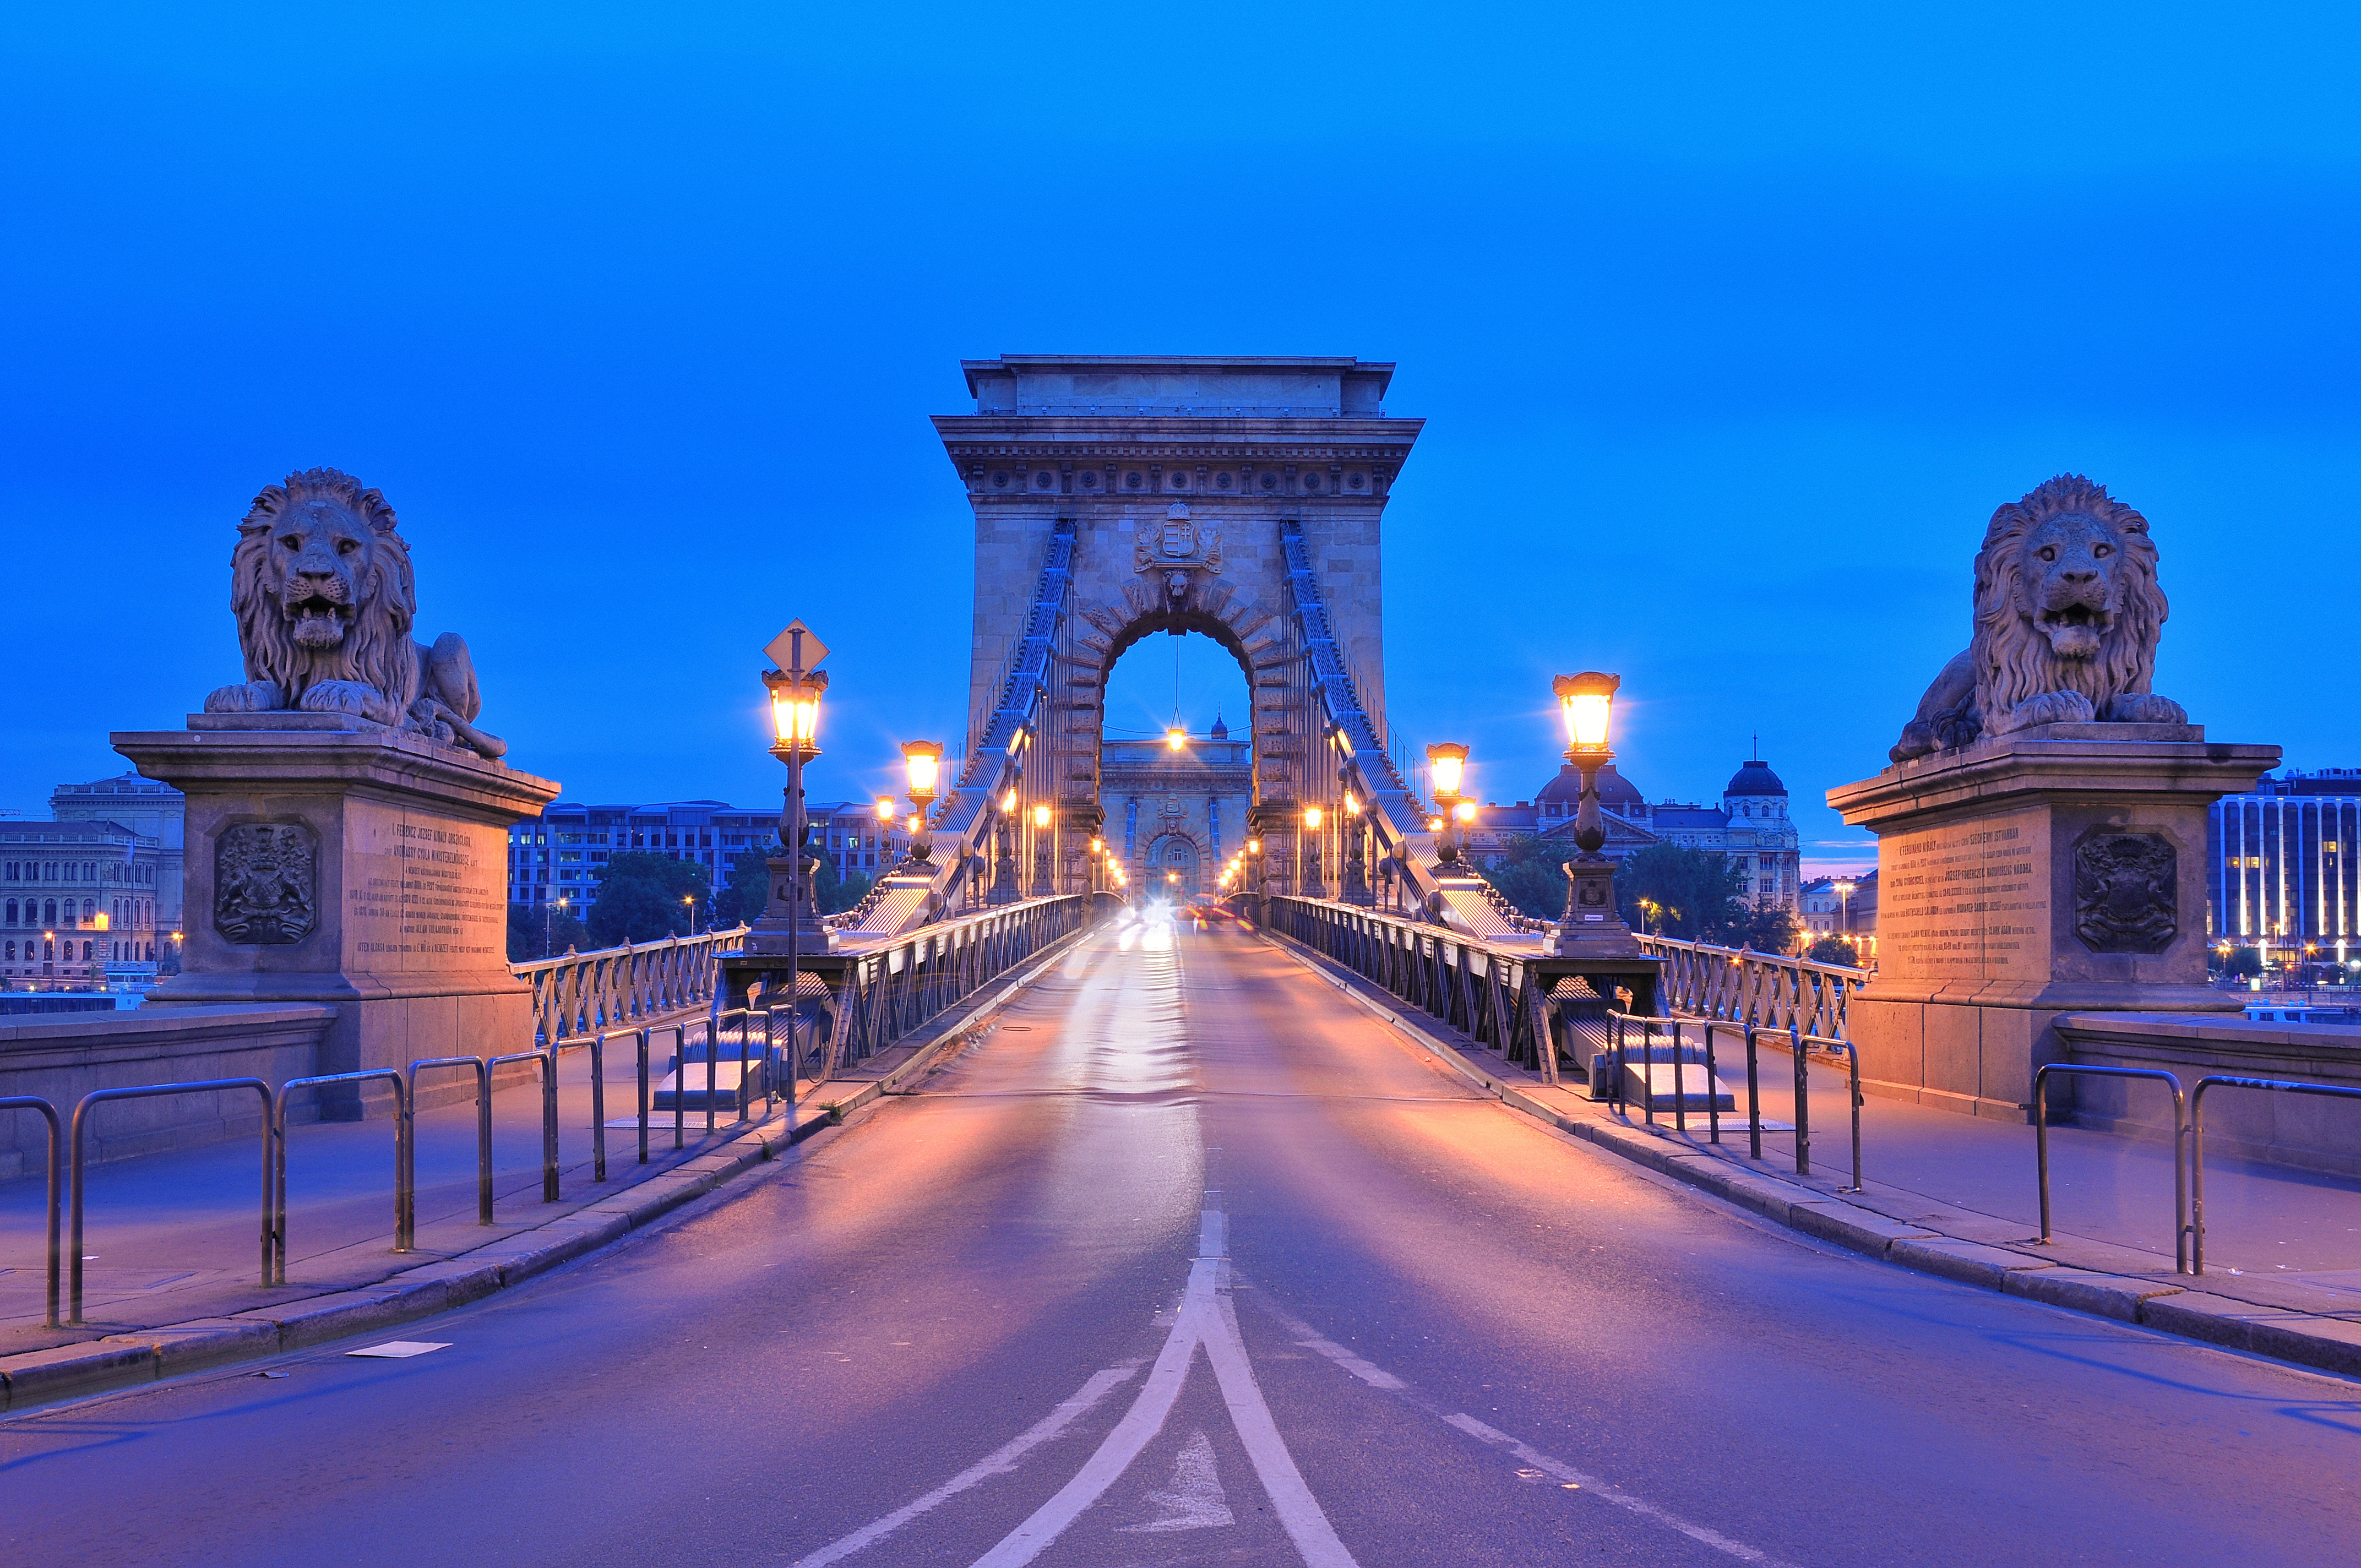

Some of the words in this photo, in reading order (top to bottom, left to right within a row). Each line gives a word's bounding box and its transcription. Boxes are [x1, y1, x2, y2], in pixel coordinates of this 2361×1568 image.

[396, 824, 416, 839] FERENCZ
[417, 824, 432, 841] JÓZSEF
[433, 827, 447, 843] KIRÁLY
[1902, 841, 1922, 856] FERDINÁND
[1922, 839, 1936, 852] KIRÁLY
[1970, 830, 1993, 845] SZÉCHENYI
[394, 842, 416, 859] ANDRÁSSY
[418, 847, 430, 861] GYULA
[1944, 866, 1960, 881] JÓZSEF
[357, 942, 369, 952] ISTEN
[371, 939, 384, 952] ÁLDÁSA
[434, 944, 449, 952] NEMZET
